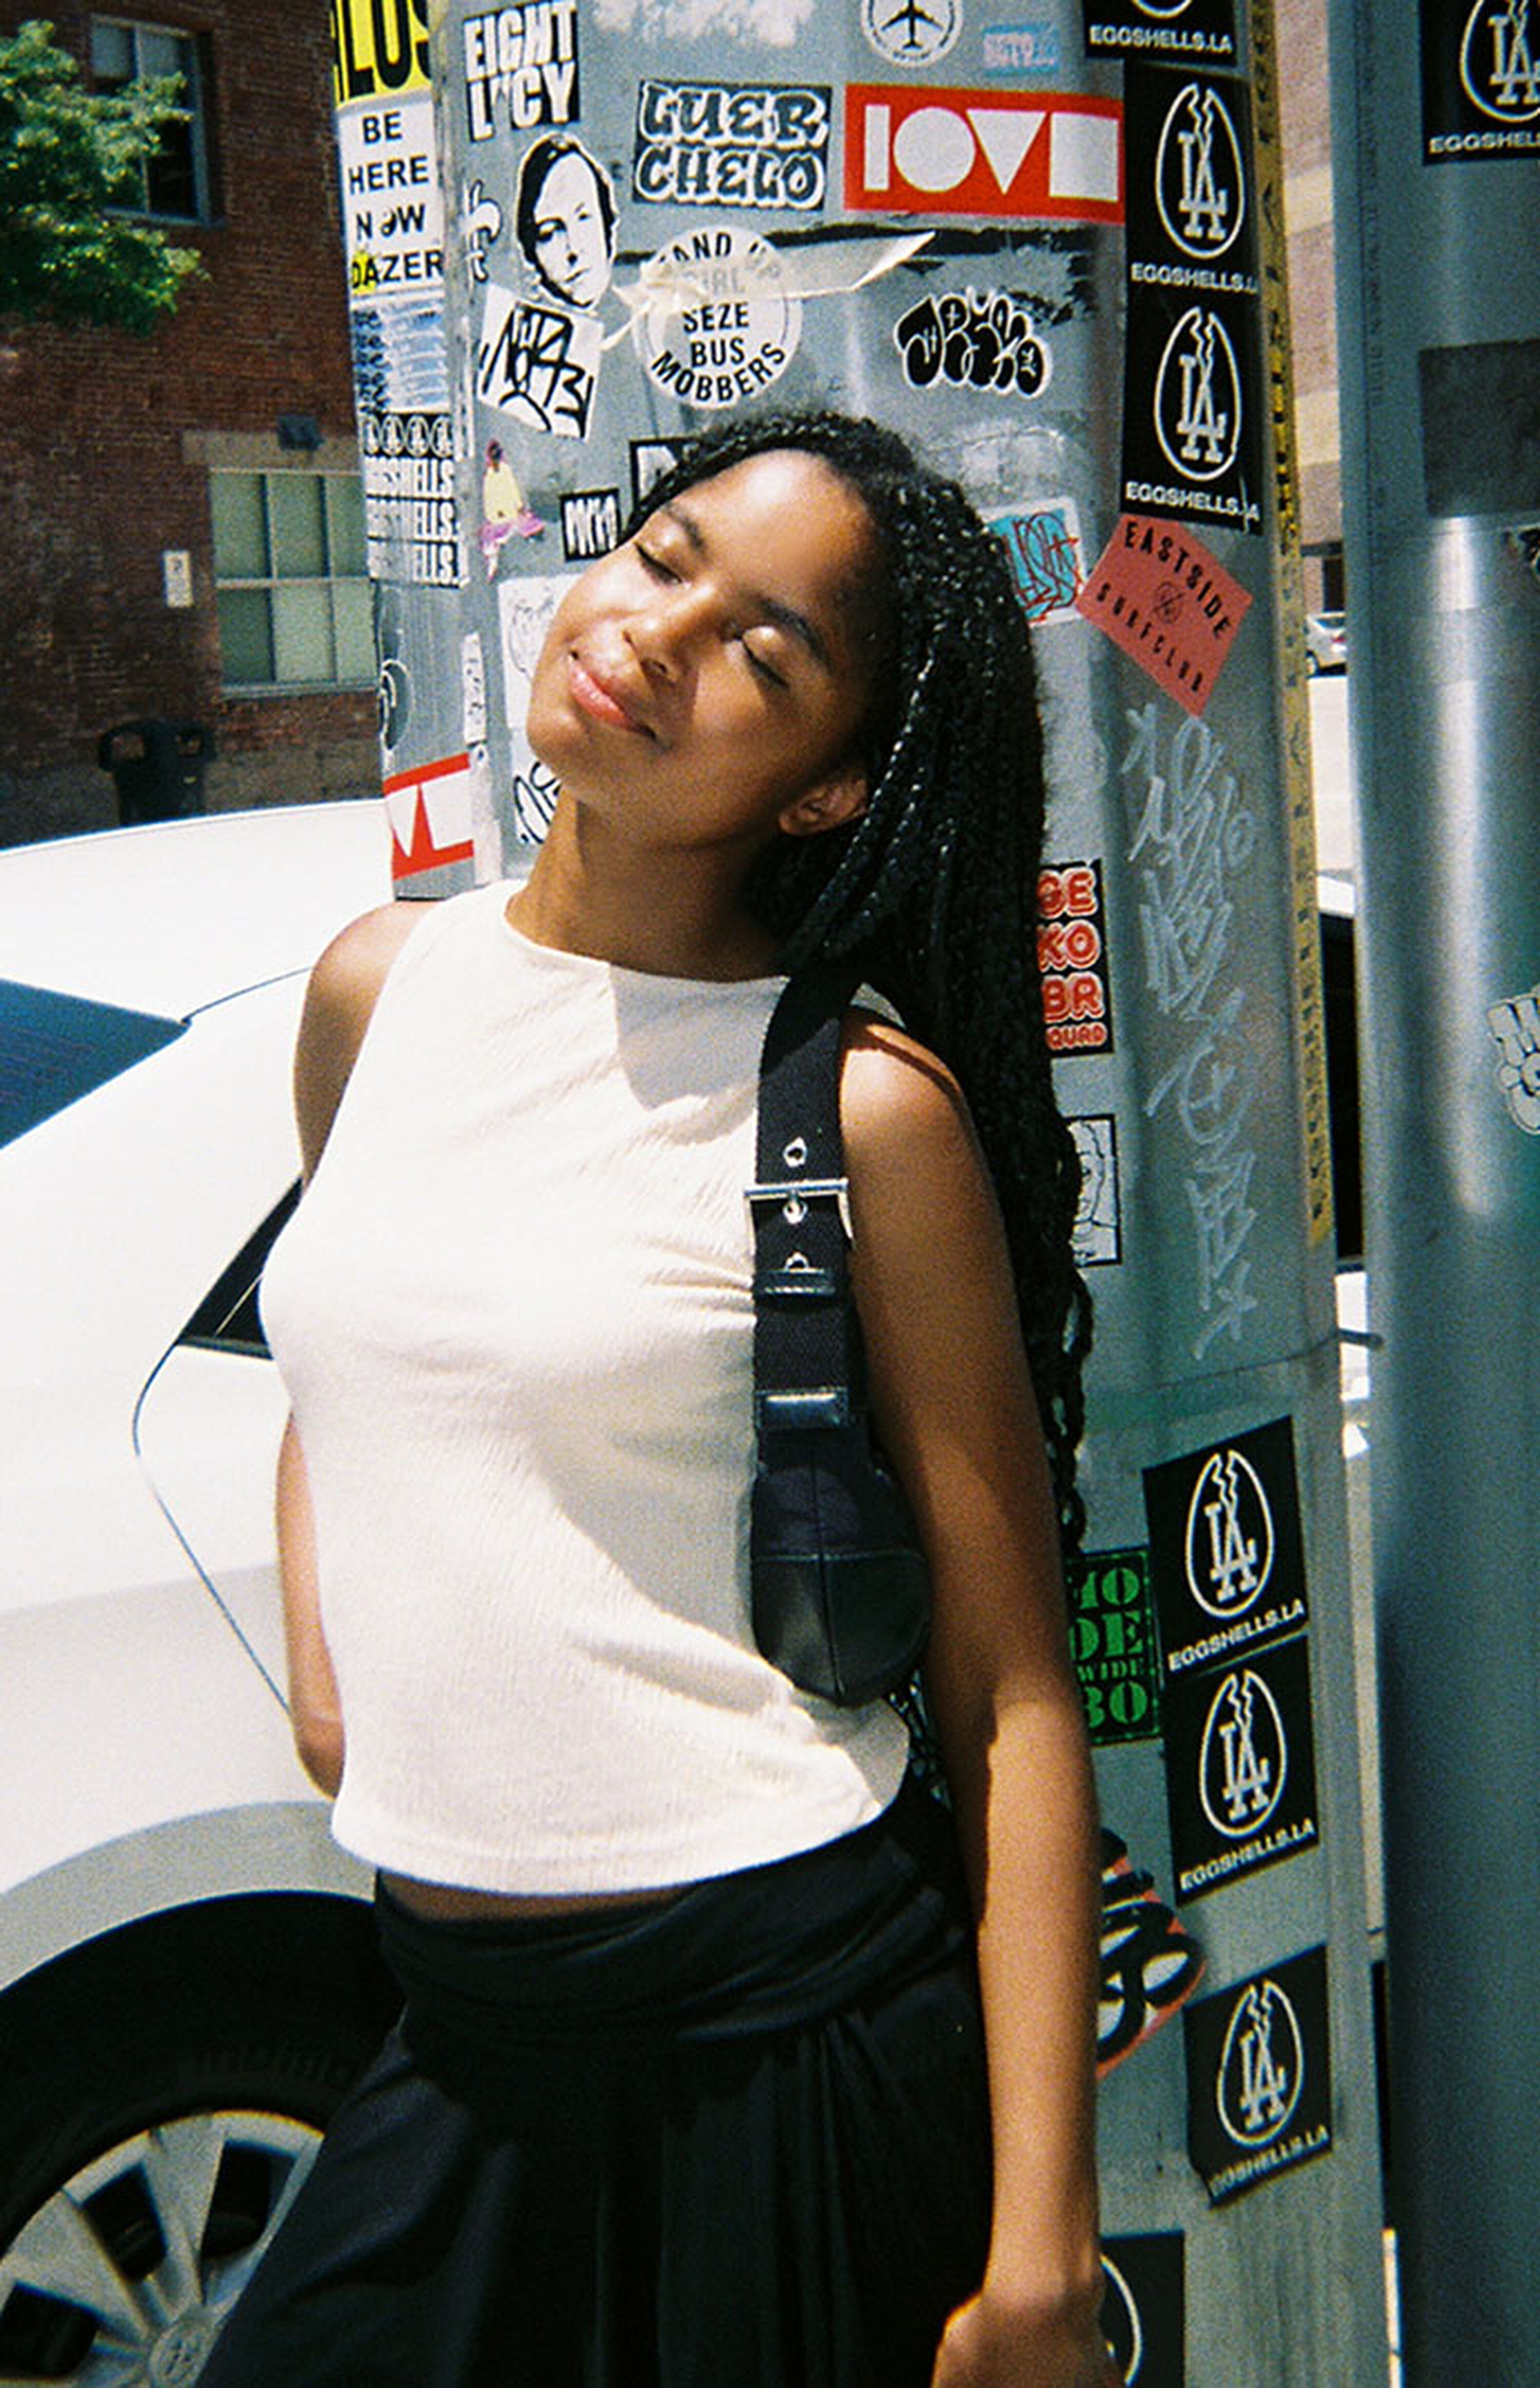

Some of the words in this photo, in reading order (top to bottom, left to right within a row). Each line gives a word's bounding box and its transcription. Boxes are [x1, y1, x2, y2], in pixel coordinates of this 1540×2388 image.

[362, 111, 402, 144] BE
[348, 155, 429, 195] HERE
[351, 249, 445, 288] DAZER
[682, 301, 749, 334] SEZE
[651, 342, 785, 401] MOBBERS
[690, 336, 745, 368] BUS
[1168, 1597, 1306, 1672] EGGSHELLS.LA
